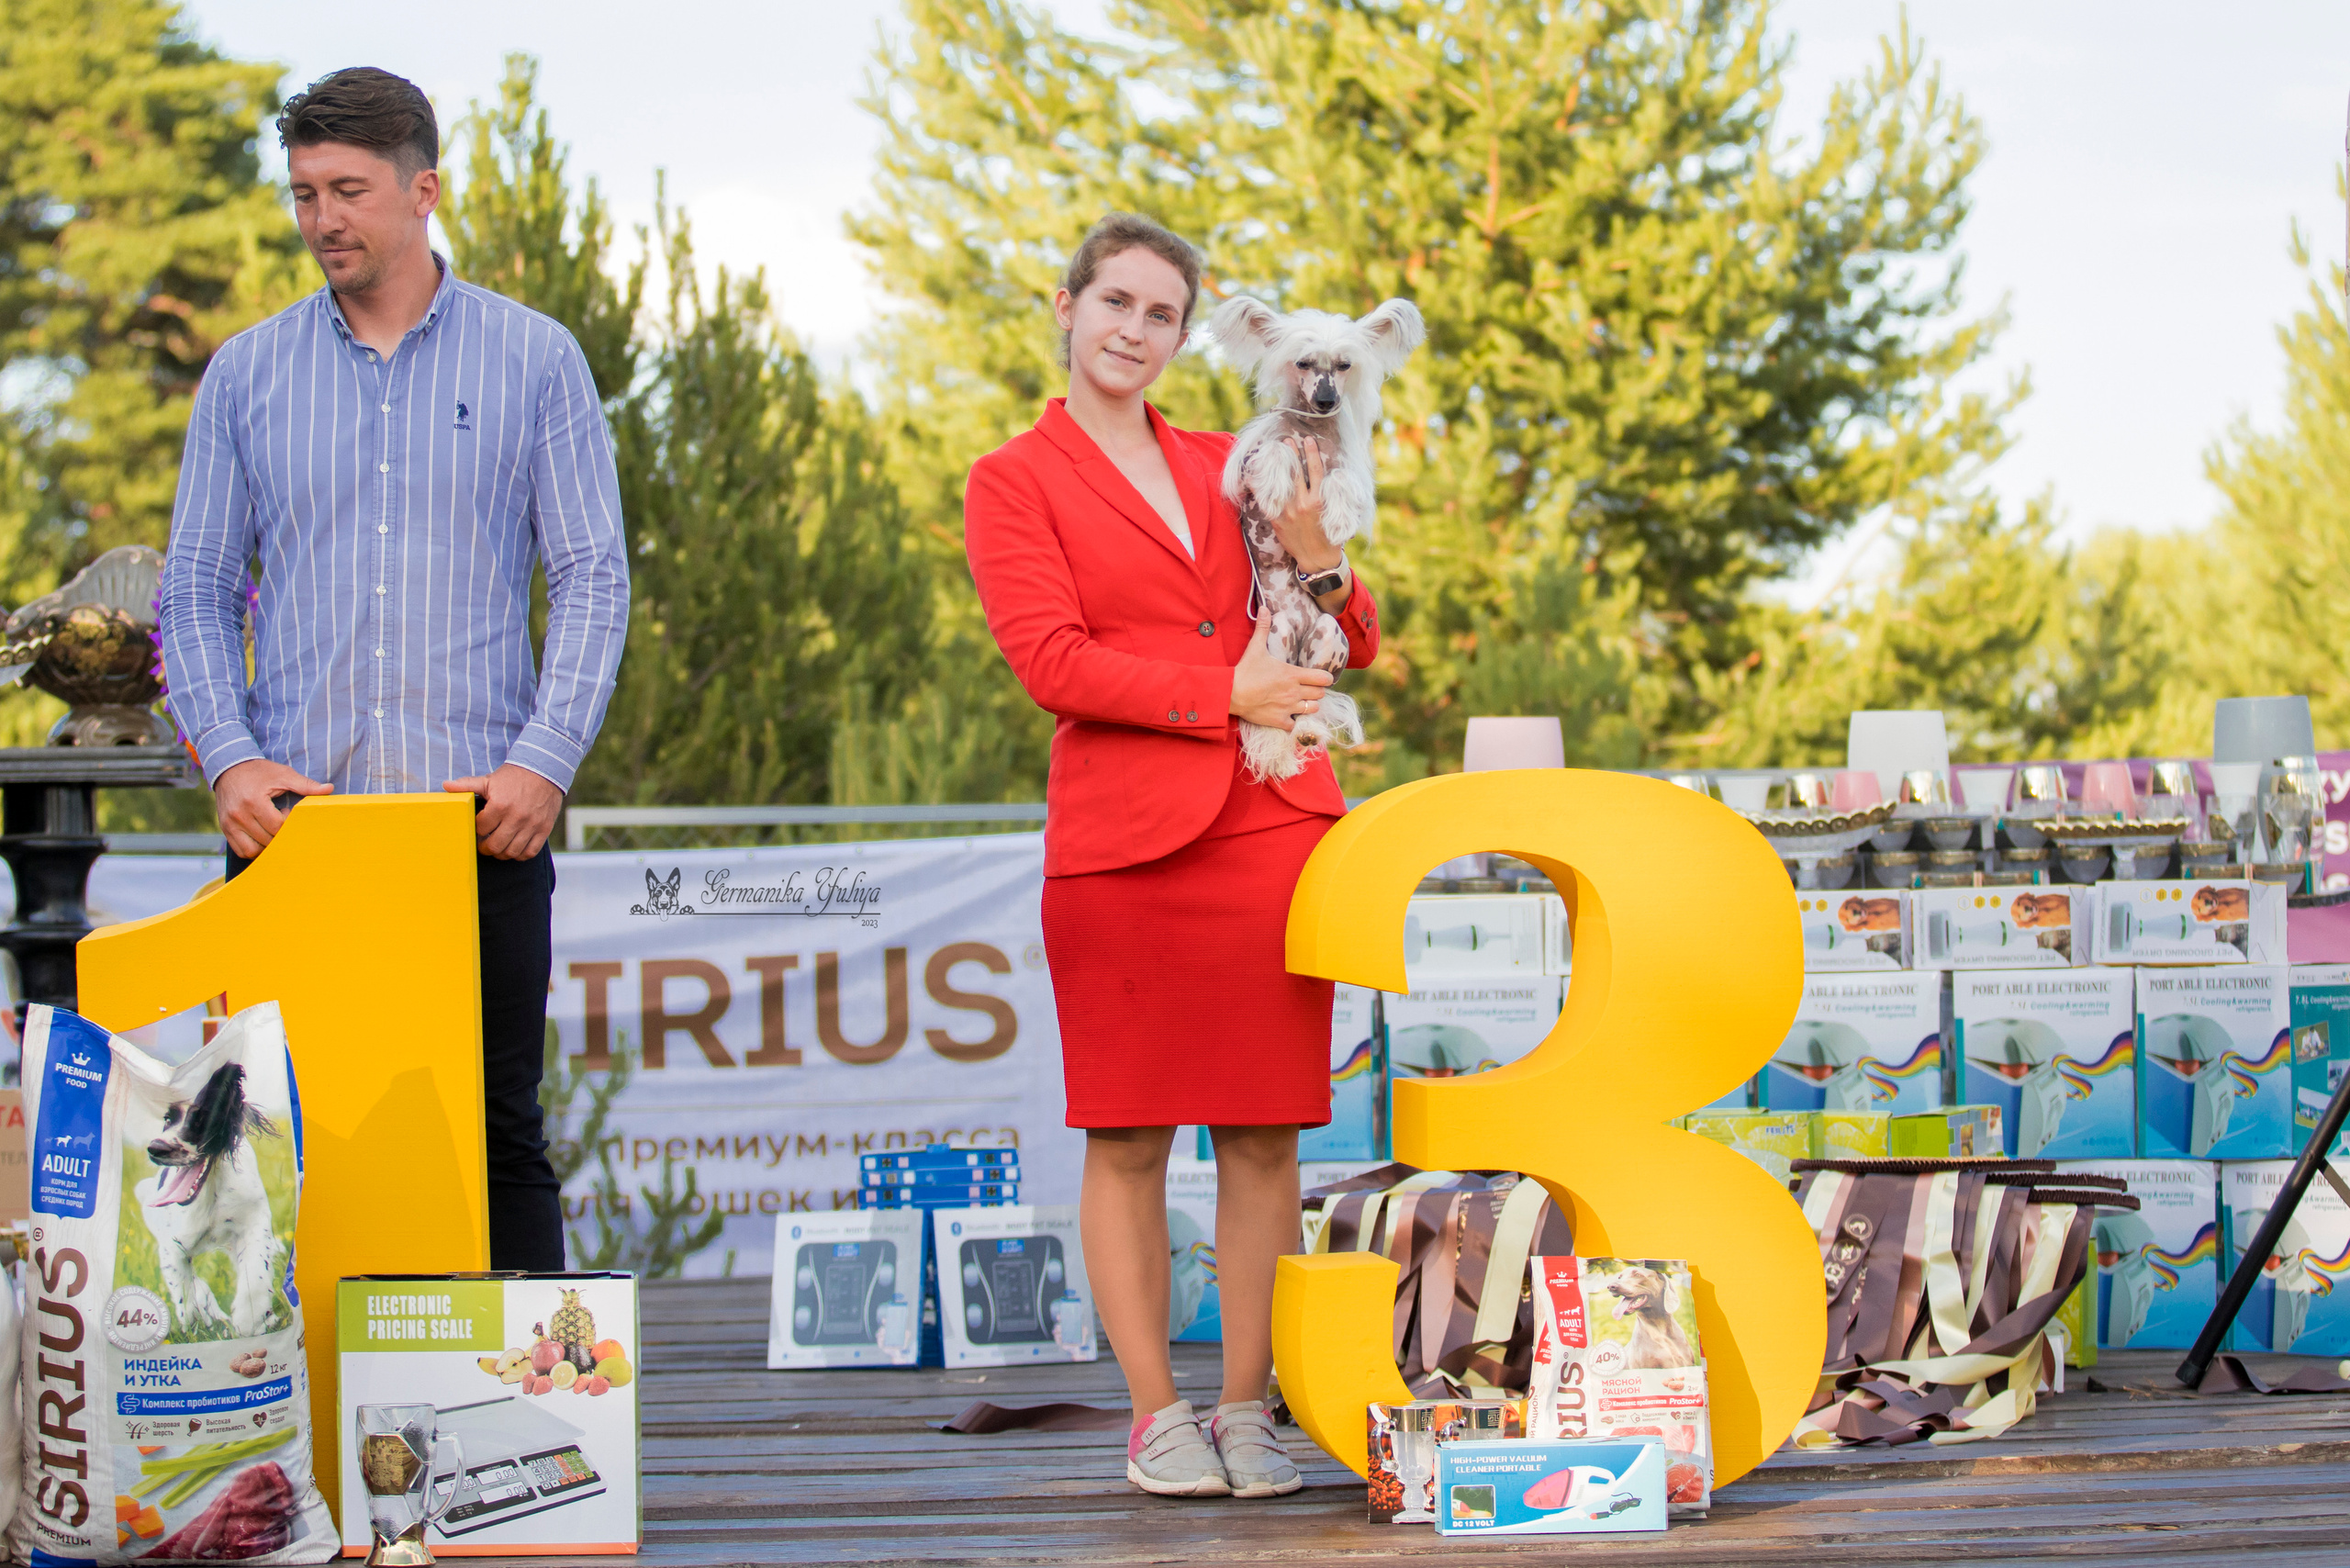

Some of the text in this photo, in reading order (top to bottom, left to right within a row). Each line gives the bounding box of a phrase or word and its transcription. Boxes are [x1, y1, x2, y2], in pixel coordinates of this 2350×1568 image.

[1973, 981, 2111, 995] PORT ABLE ELECTRONIC
[2149, 977, 2272, 991] PORT ABLE ELECTRONIC
[1430, 991, 1460, 1002] ABLE
[1462, 989, 1538, 1001] ELECTRONIC
[1808, 984, 1919, 999] ABLE ELECTRONIC
[548, 942, 1018, 1071] IRIUS
[55, 1062, 103, 1082] PREMIUM
[66, 1077, 88, 1089] FOOD
[1273, 769, 1827, 1485] 3
[76, 793, 491, 1515] 1
[41, 1153, 92, 1178] ADULT
[50, 1178, 78, 1189] КОРМ ДЛЯ
[2126, 1170, 2196, 1184] ELECTRONIC
[2235, 1172, 2284, 1185] PORT ABLE
[40, 1186, 87, 1199] ВЗРОСЛЫХ СОБАК
[41, 1195, 84, 1209] СРЕДНИХ ПОРОД
[644, 1187, 812, 1217] ошек
[833, 1190, 859, 1212] и
[105, 1294, 120, 1325] ВЫСОКОЕ
[119, 1287, 163, 1307] СОДЕРЖАНИЕ
[367, 1294, 452, 1316] ELECTRONIC
[117, 1308, 159, 1328] 44%
[1560, 1318, 1583, 1328] ADULT
[368, 1318, 473, 1339] PRICING SCALE
[124, 1356, 203, 1372] ИНДЕЙКА
[1595, 1351, 1620, 1364] 40%
[270, 1362, 288, 1374] 12 кг
[124, 1374, 182, 1387] И УТКА
[1602, 1376, 1642, 1387] МЯСНОЙ
[35, 1247, 90, 1528] SIRIUS
[1602, 1386, 1641, 1395] РАЦИОН
[142, 1384, 289, 1409] Комплекс пробиотиков ProStor+
[1669, 1397, 1701, 1406] ProStor+
[269, 1406, 289, 1417] Здоровое
[152, 1420, 181, 1429] Здоровая
[206, 1417, 231, 1426] Высокая
[206, 1424, 247, 1434] питательность
[1450, 1456, 1508, 1464] HIGH-POWER
[496, 1469, 515, 1479] 0.00
[1455, 1464, 1541, 1473] CLEANER PORTABLE
[506, 1484, 526, 1496] 0.00
[37, 1522, 92, 1548] PREMIUM
